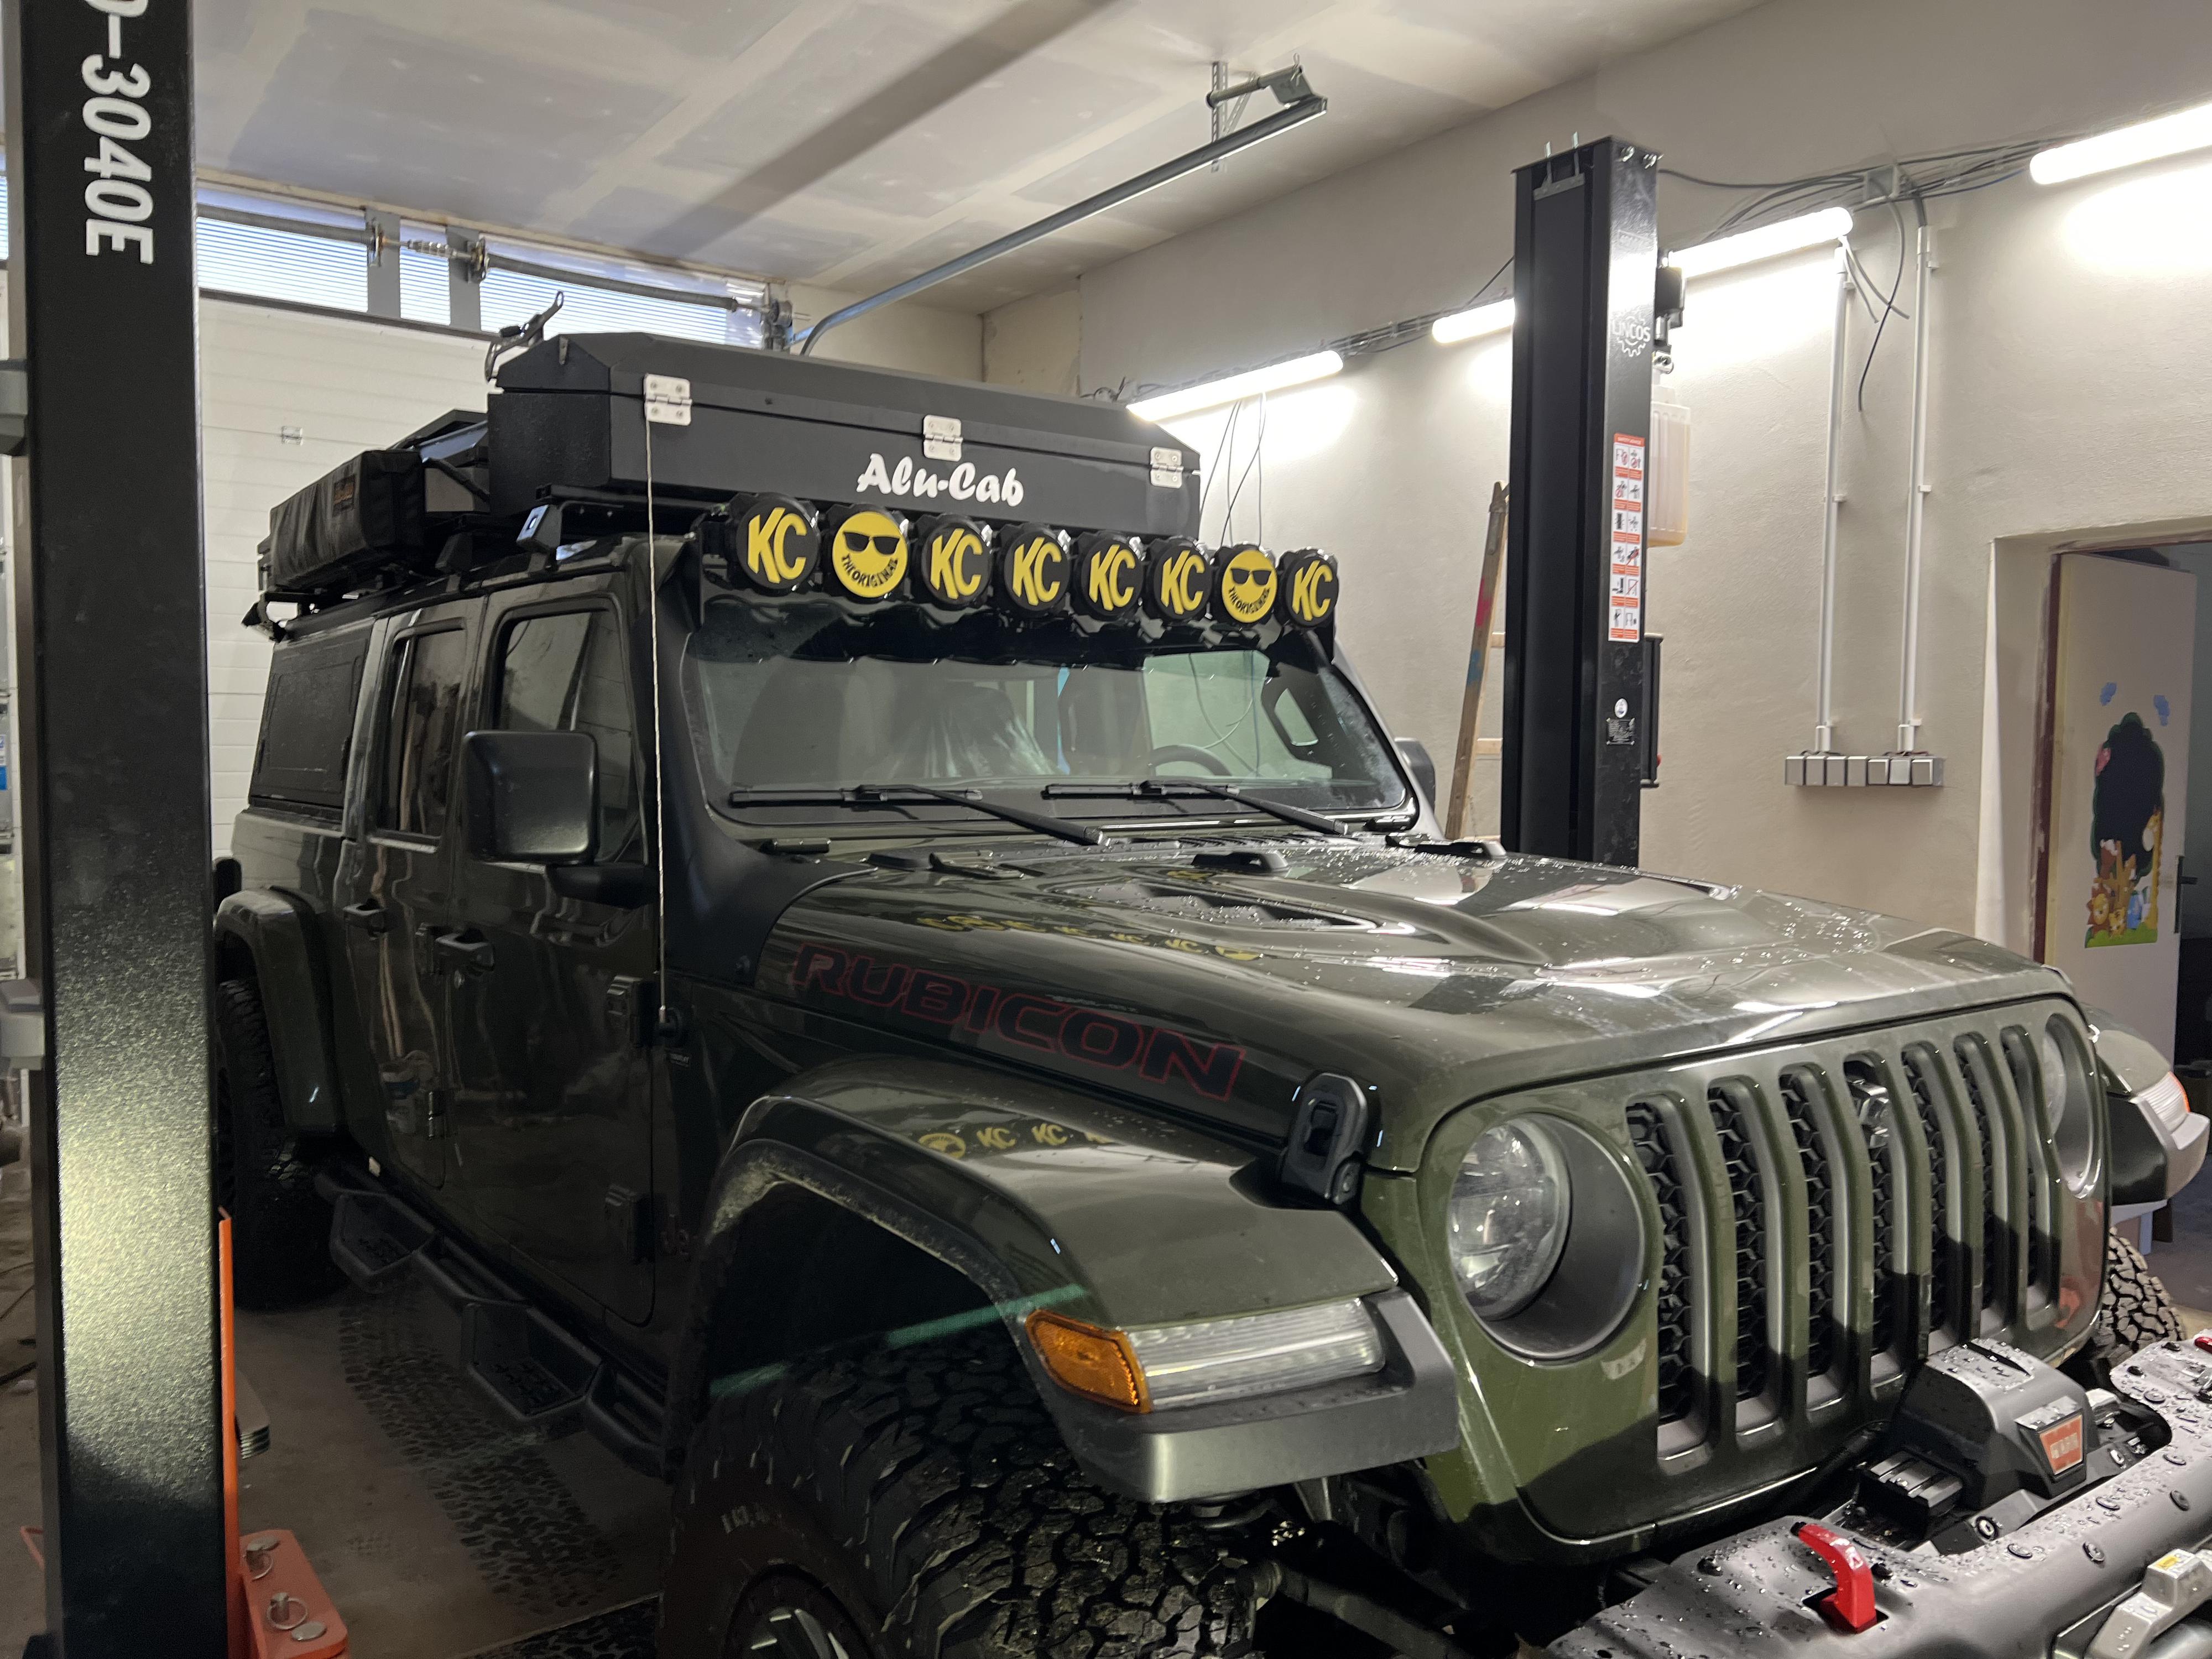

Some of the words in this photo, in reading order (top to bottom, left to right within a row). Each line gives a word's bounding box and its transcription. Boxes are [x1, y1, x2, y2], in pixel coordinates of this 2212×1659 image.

[1612, 319, 1651, 343] LINCOS
[855, 453, 1025, 507] Alu-Cab
[747, 507, 807, 584] KC
[931, 528, 983, 599] KC
[1013, 536, 1062, 605] KC
[1090, 544, 1136, 611] KC
[1161, 550, 1204, 614] KC
[1292, 560, 1333, 620] KC
[791, 942, 1245, 1102] RUBICON
